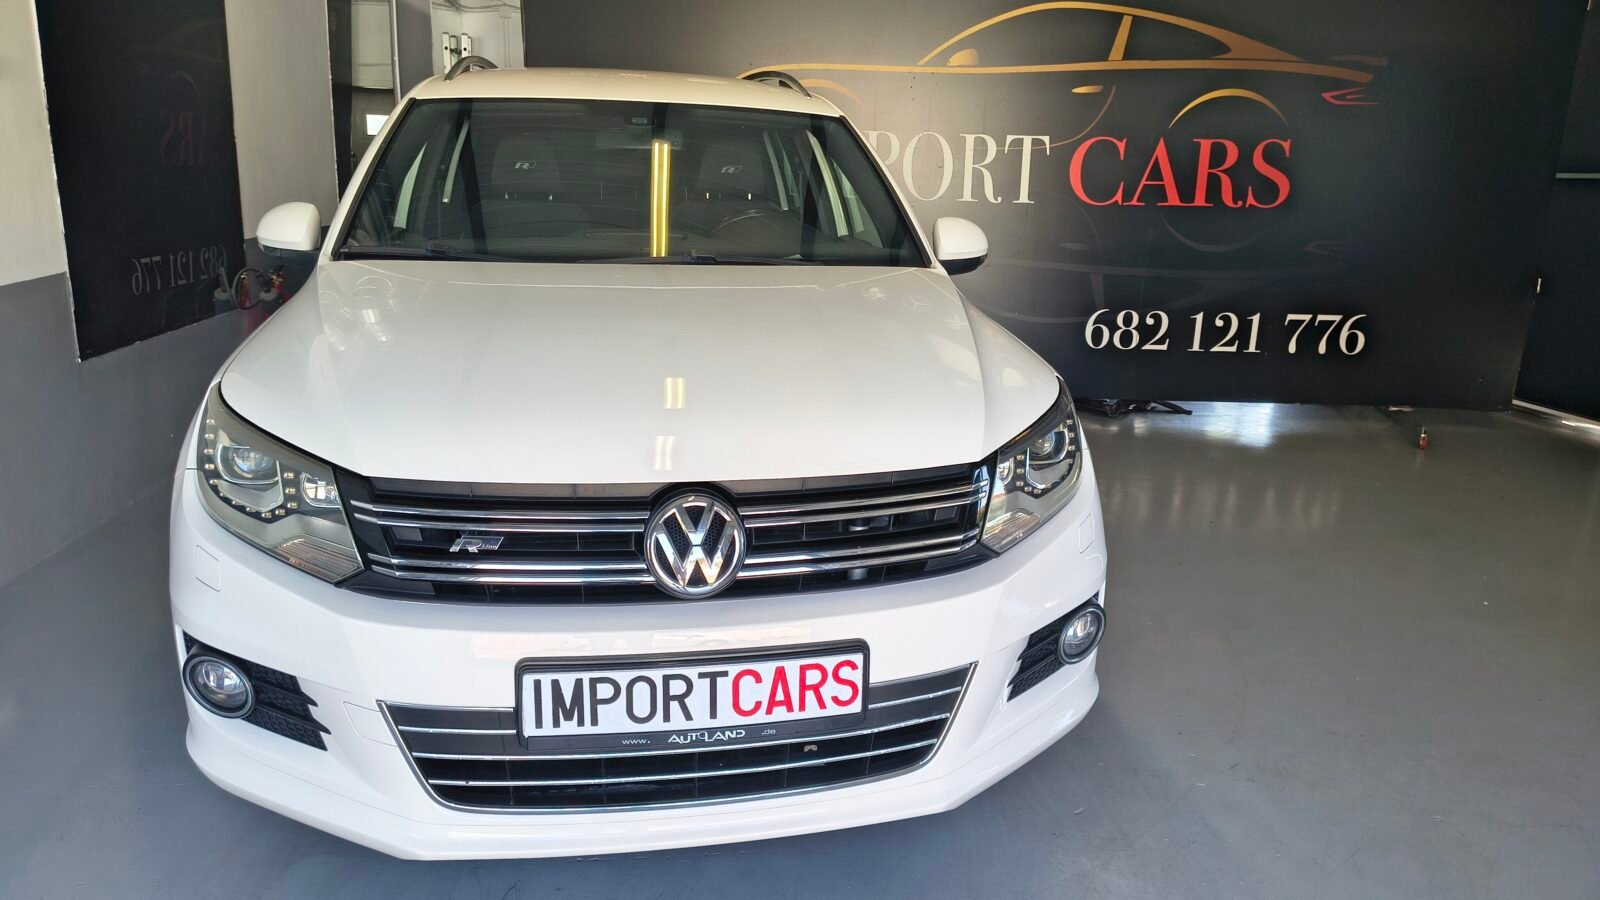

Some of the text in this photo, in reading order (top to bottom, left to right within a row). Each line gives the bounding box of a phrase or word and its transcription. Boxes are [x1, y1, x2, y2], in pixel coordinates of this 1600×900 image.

[1069, 136, 1291, 208] CARS
[1084, 309, 1367, 355] 682 121 776
[532, 659, 860, 730] IMPORTCARS
[761, 728, 776, 736] .de
